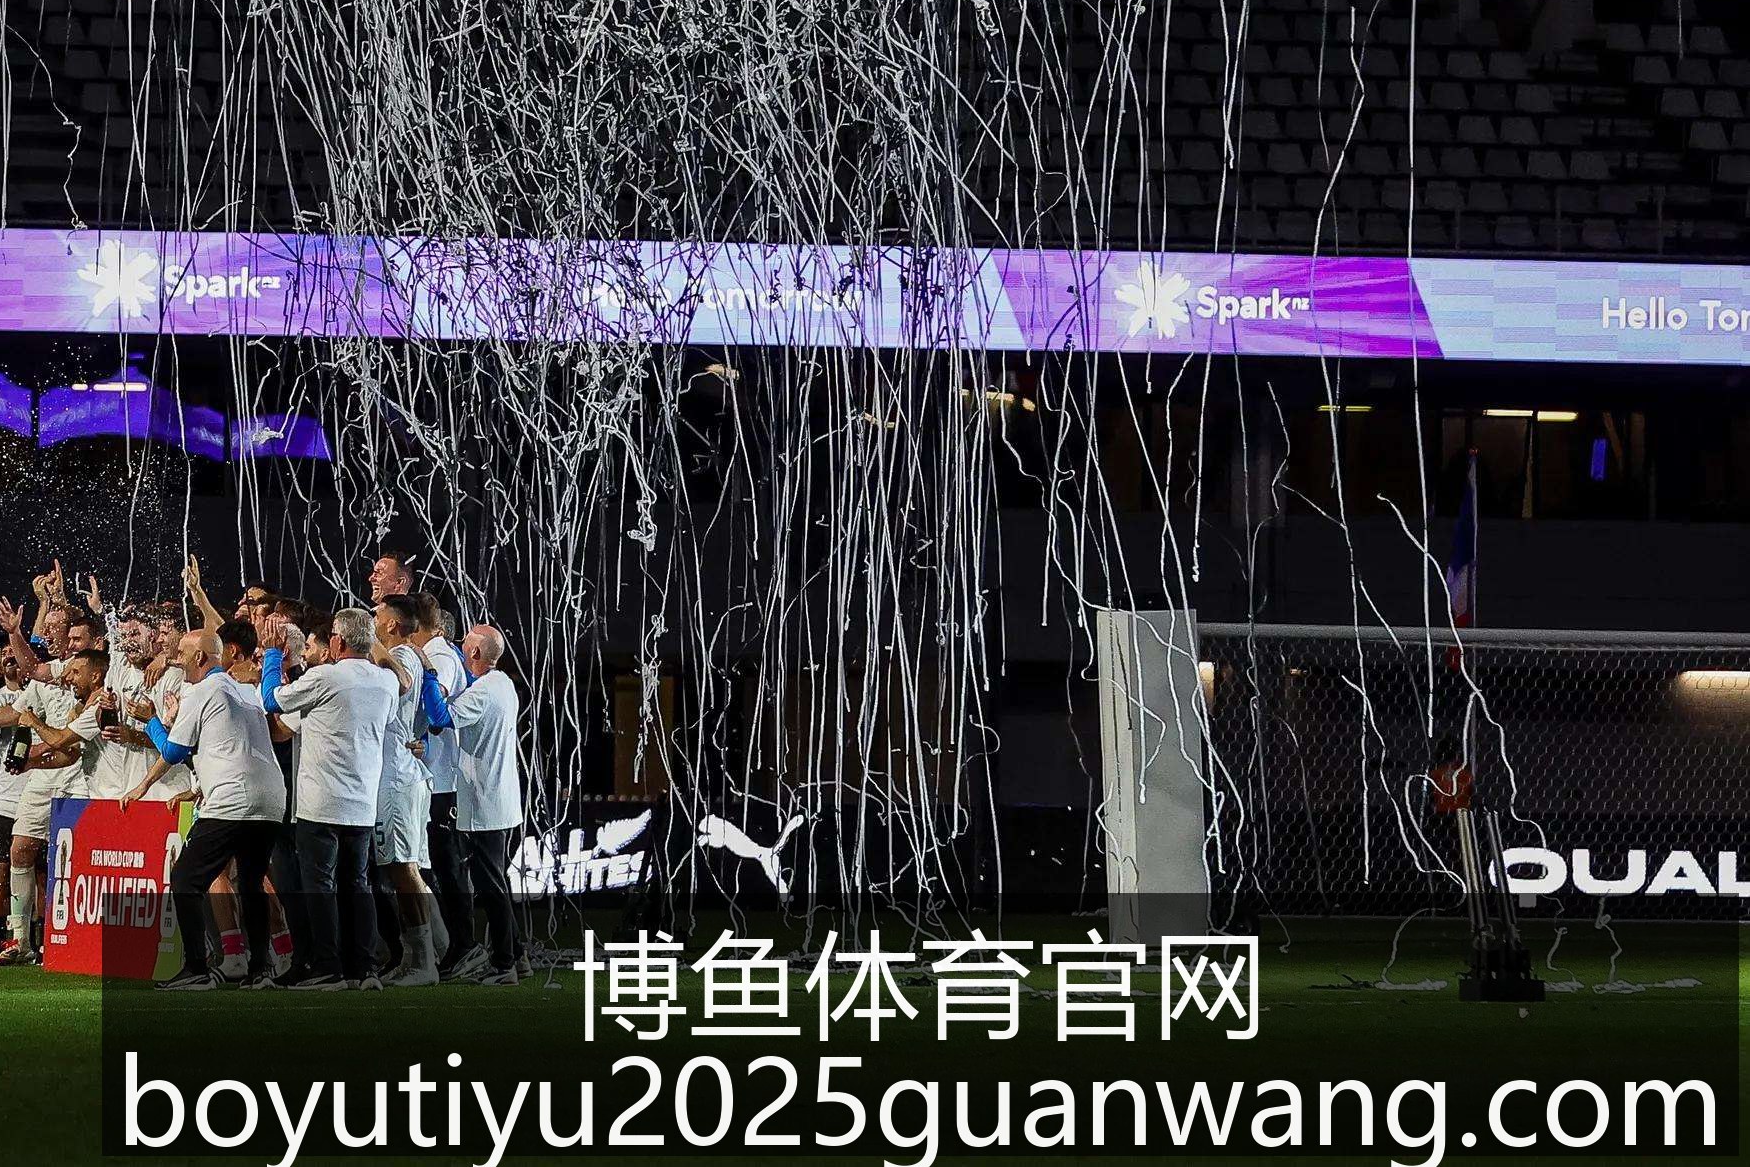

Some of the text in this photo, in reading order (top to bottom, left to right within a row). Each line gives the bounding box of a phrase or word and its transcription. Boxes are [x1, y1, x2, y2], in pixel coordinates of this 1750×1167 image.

[165, 265, 261, 304] Spark
[1196, 286, 1291, 321] Spark
[1602, 296, 1689, 330] Hello
[103, 850, 123, 867] WORLD
[122, 851, 134, 868] CUP
[1488, 846, 1750, 908] QUAL
[74, 874, 157, 928] QUALIFIED
